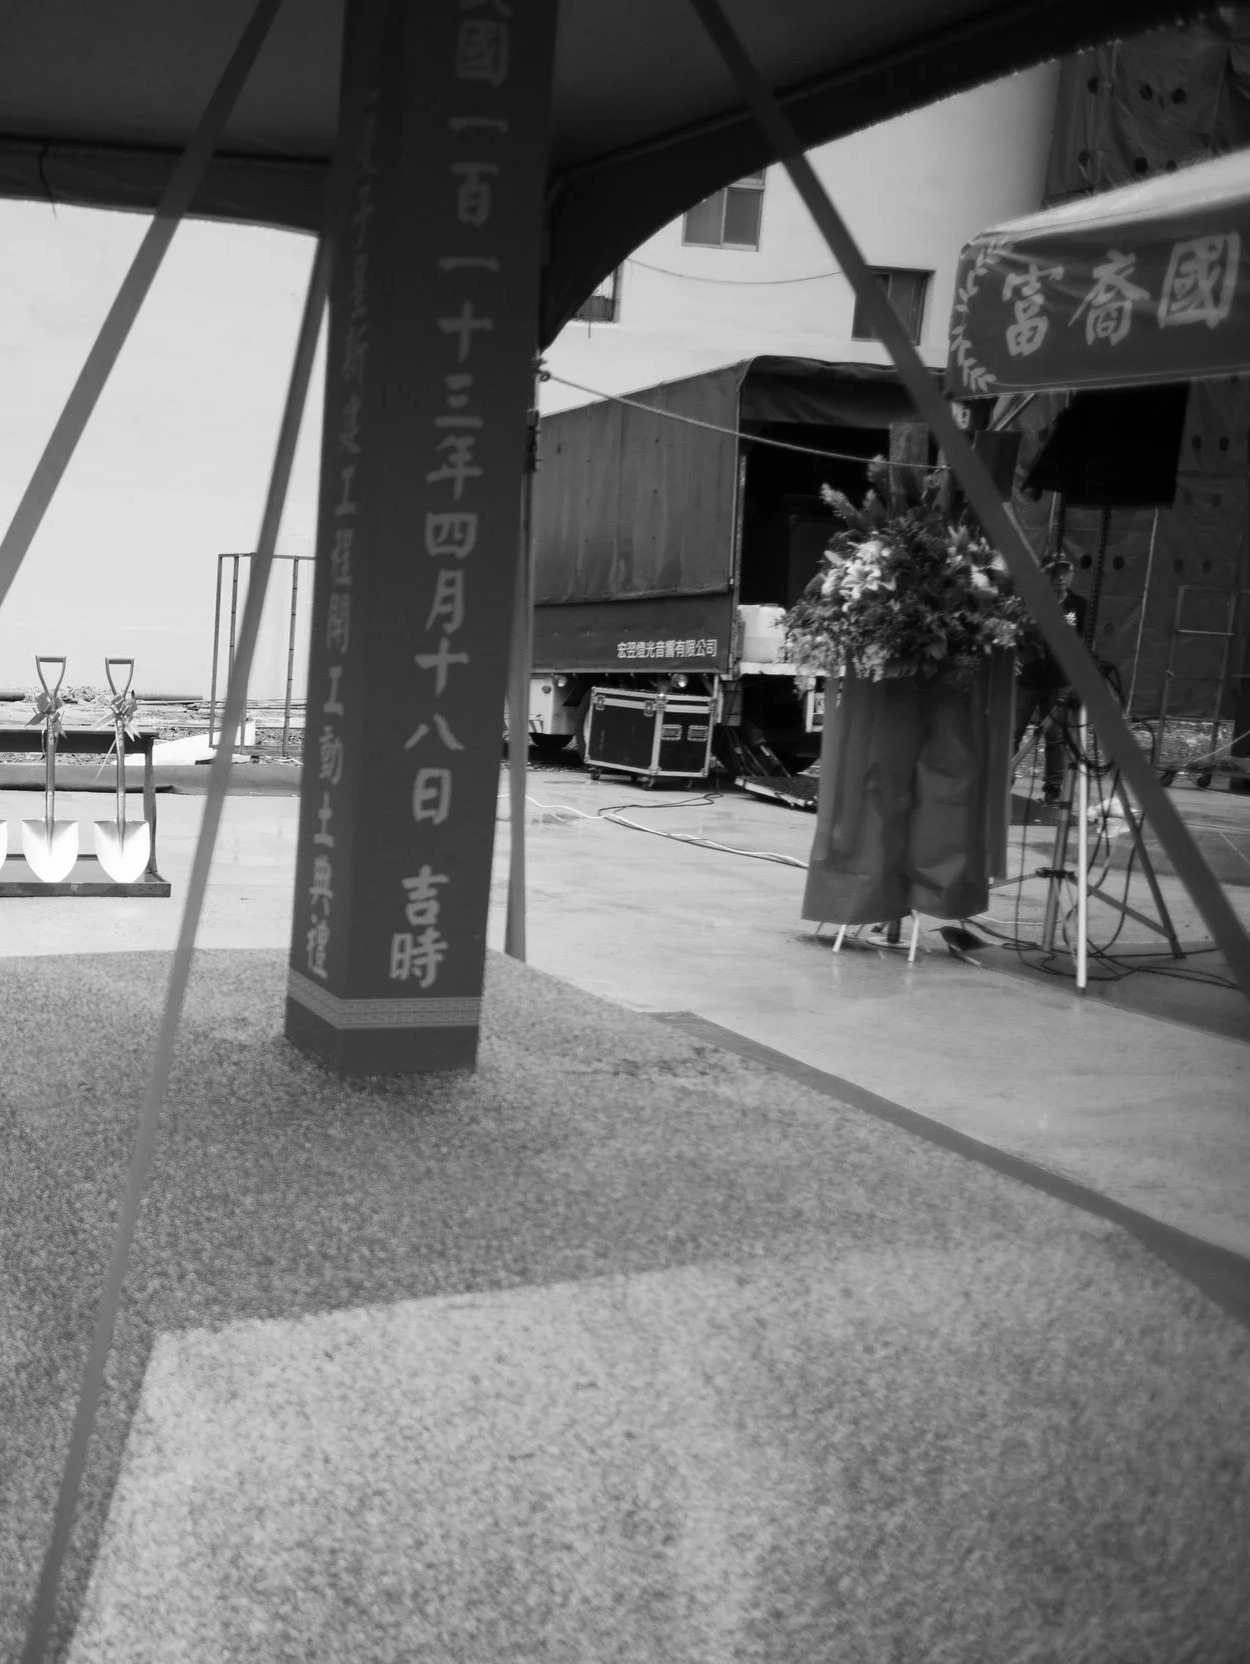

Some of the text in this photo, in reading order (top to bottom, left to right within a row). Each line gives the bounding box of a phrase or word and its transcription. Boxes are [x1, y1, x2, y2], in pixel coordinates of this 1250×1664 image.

[388, 0, 510, 990] 國一百一十三年四月十八日 吉時
